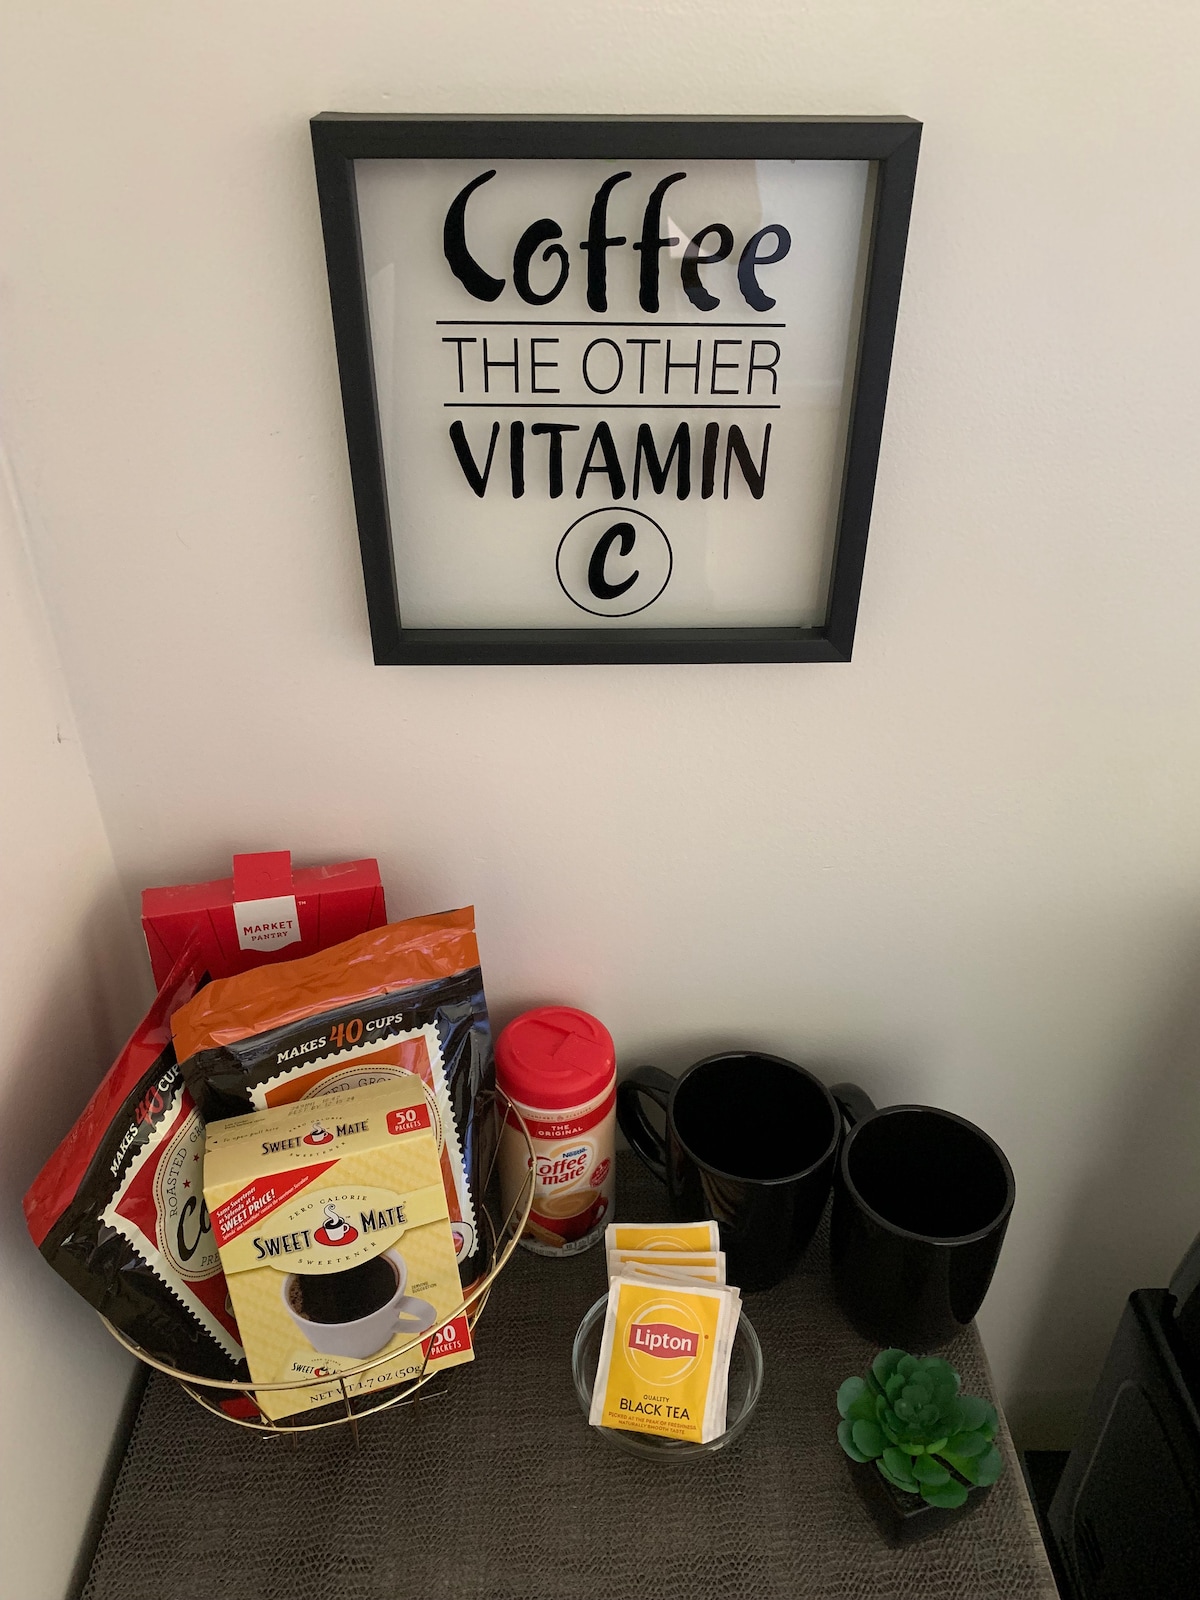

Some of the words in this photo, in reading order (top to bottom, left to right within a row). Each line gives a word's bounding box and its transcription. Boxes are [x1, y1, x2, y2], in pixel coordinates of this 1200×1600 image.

[443, 169, 791, 313] Coffee
[442, 337, 560, 394] THE
[582, 337, 781, 395] OTHER
[449, 420, 772, 500] VITAMIN
[588, 522, 639, 600] C
[243, 920, 293, 936] MARKET
[251, 931, 288, 941] PANTRY
[276, 1036, 327, 1064] MAKES
[329, 1018, 364, 1048] 40
[365, 1013, 403, 1032] CUPS
[395, 1109, 417, 1125] 50
[395, 1120, 421, 1132] PACKETS
[110, 1122, 139, 1178] MAKES
[135, 1085, 164, 1127] 40
[261, 1136, 302, 1155] SWEET
[336, 1120, 369, 1138] MATE
[538, 1127, 584, 1137] ORIGINAL
[166, 1147, 188, 1218] ROASTED
[542, 1165, 585, 1186] mate
[220, 1209, 247, 1235] SWEET
[248, 1188, 275, 1216] PRICE!
[288, 1203, 314, 1221] ZERO
[319, 1194, 368, 1204] CALORIE
[253, 1229, 310, 1260] SWEET
[360, 1205, 407, 1233] MATE
[298, 1241, 377, 1266] SWEETENER
[431, 1339, 462, 1356] PACKETS
[635, 1328, 692, 1352] Lipton
[291, 1362, 315, 1374] SWEET
[309, 1391, 334, 1403] NET
[357, 1378, 374, 1389] 1.7
[377, 1371, 393, 1383] OZ
[643, 1394, 670, 1403] QUALITY
[608, 1411, 627, 1420] PICKED
[645, 1417, 659, 1425] PEAK
[667, 1421, 697, 1431] FRESHNESS
[619, 1398, 662, 1417] BLACK
[665, 1405, 690, 1421] TEA
[618, 1420, 645, 1429] NATURALLY
[648, 1424, 669, 1432] SMOOTH
[670, 1427, 685, 1435] TASTE
